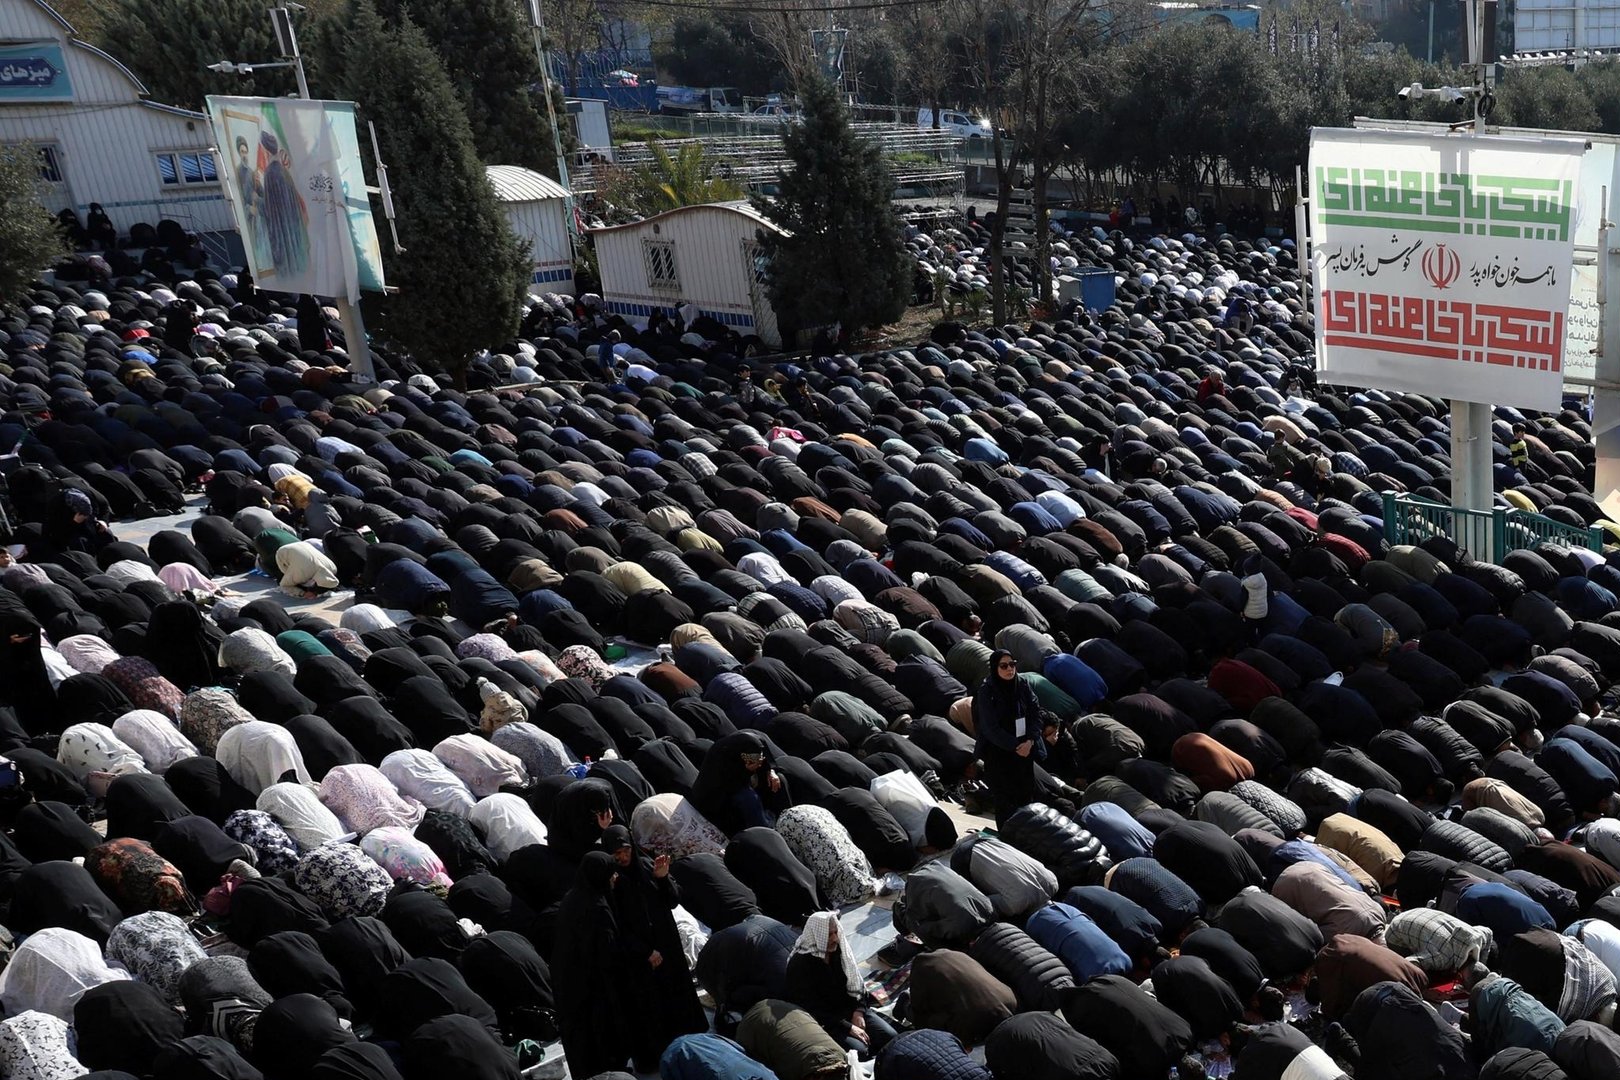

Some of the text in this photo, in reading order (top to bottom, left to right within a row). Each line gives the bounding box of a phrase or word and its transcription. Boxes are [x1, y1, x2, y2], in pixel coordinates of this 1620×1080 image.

[1321, 246, 1342, 273] پسر
[1340, 244, 1365, 271] فرمان
[1366, 234, 1423, 277] گوش
[1469, 261, 1482, 287] پدر
